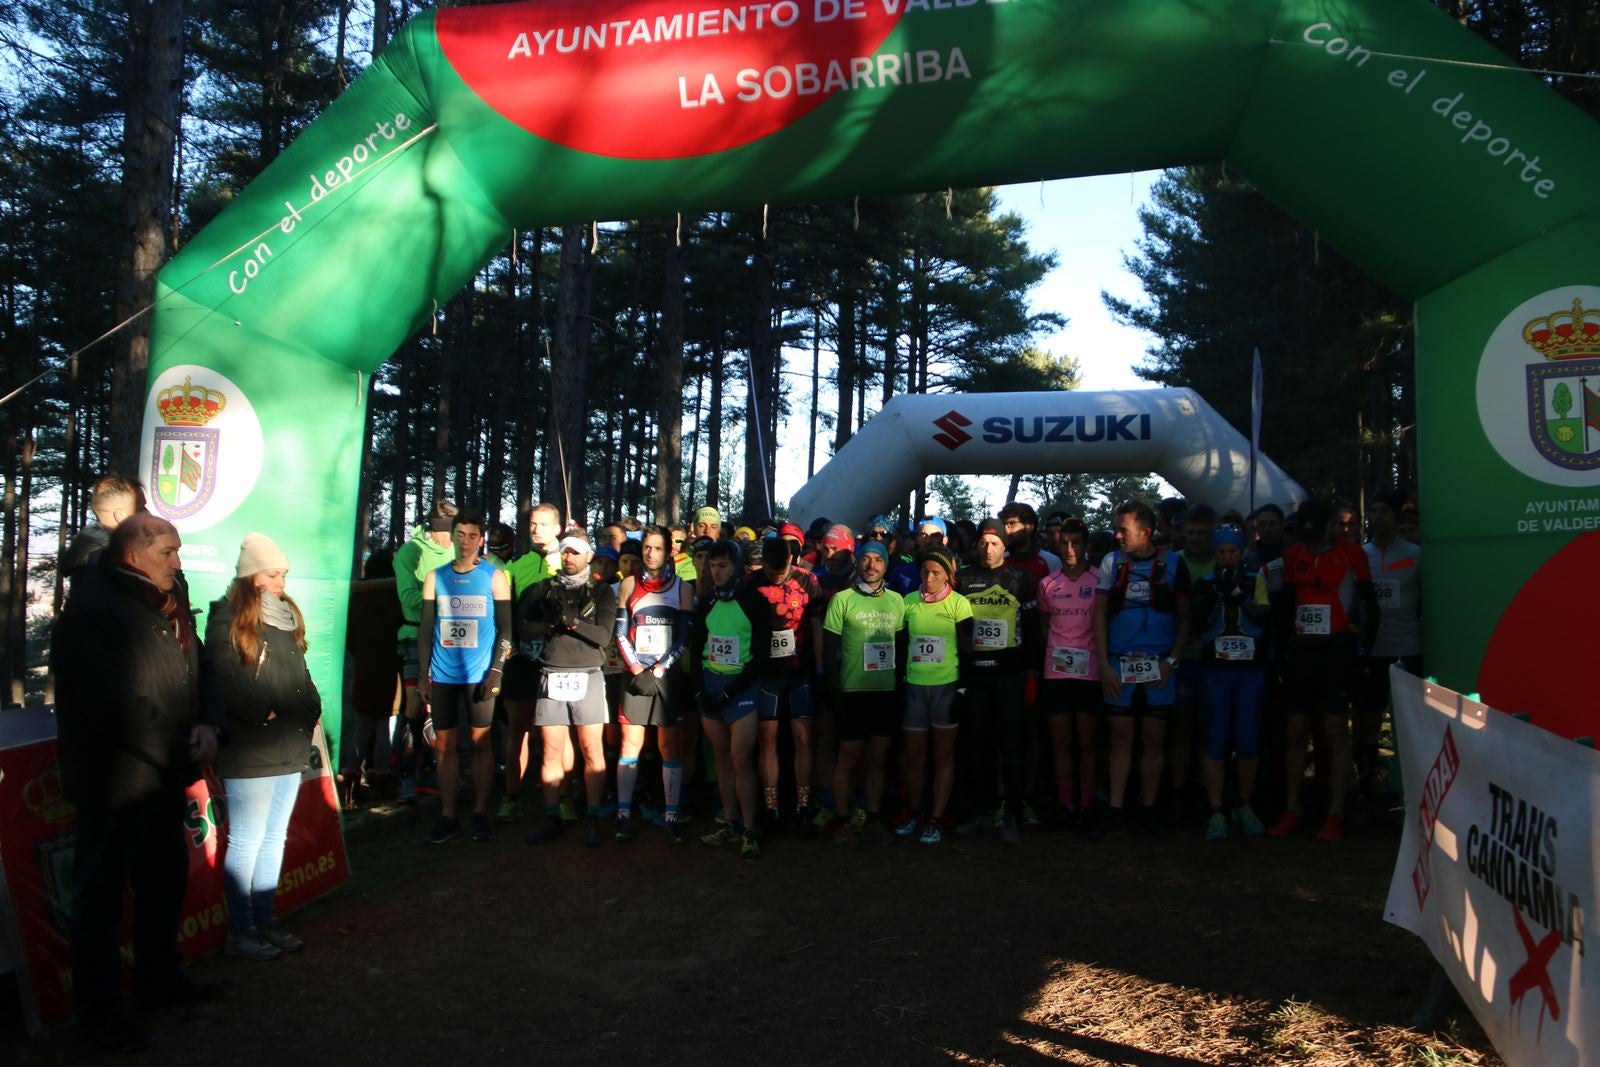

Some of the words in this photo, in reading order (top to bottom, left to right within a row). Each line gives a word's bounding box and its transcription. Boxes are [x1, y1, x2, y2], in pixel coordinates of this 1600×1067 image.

[508, 1, 799, 59] AYUNTAMIENTO
[815, 0, 867, 22] DE
[678, 73, 725, 108] LA
[735, 47, 972, 103] SOBARRIBA
[1303, 22, 1371, 68] Con
[1387, 69, 1426, 94] el
[1432, 92, 1555, 199] deporte
[229, 242, 272, 294] Con
[280, 201, 302, 233] el
[309, 112, 411, 201] deporte
[982, 414, 1153, 444] SUZUKI
[1525, 498, 1600, 514] AYUNTAM
[1517, 519, 1539, 532] DE
[1299, 613, 1322, 623] 485
[450, 627, 466, 638] 20
[977, 627, 1001, 638] 363
[711, 644, 732, 654] 142
[772, 639, 788, 648] 86
[919, 644, 934, 654] 10
[1222, 641, 1247, 651] 259
[879, 650, 886, 660] 9
[1066, 656, 1073, 666] 3
[1128, 662, 1152, 674] 463
[555, 681, 580, 691] 413
[1489, 782, 1558, 878] TRANS
